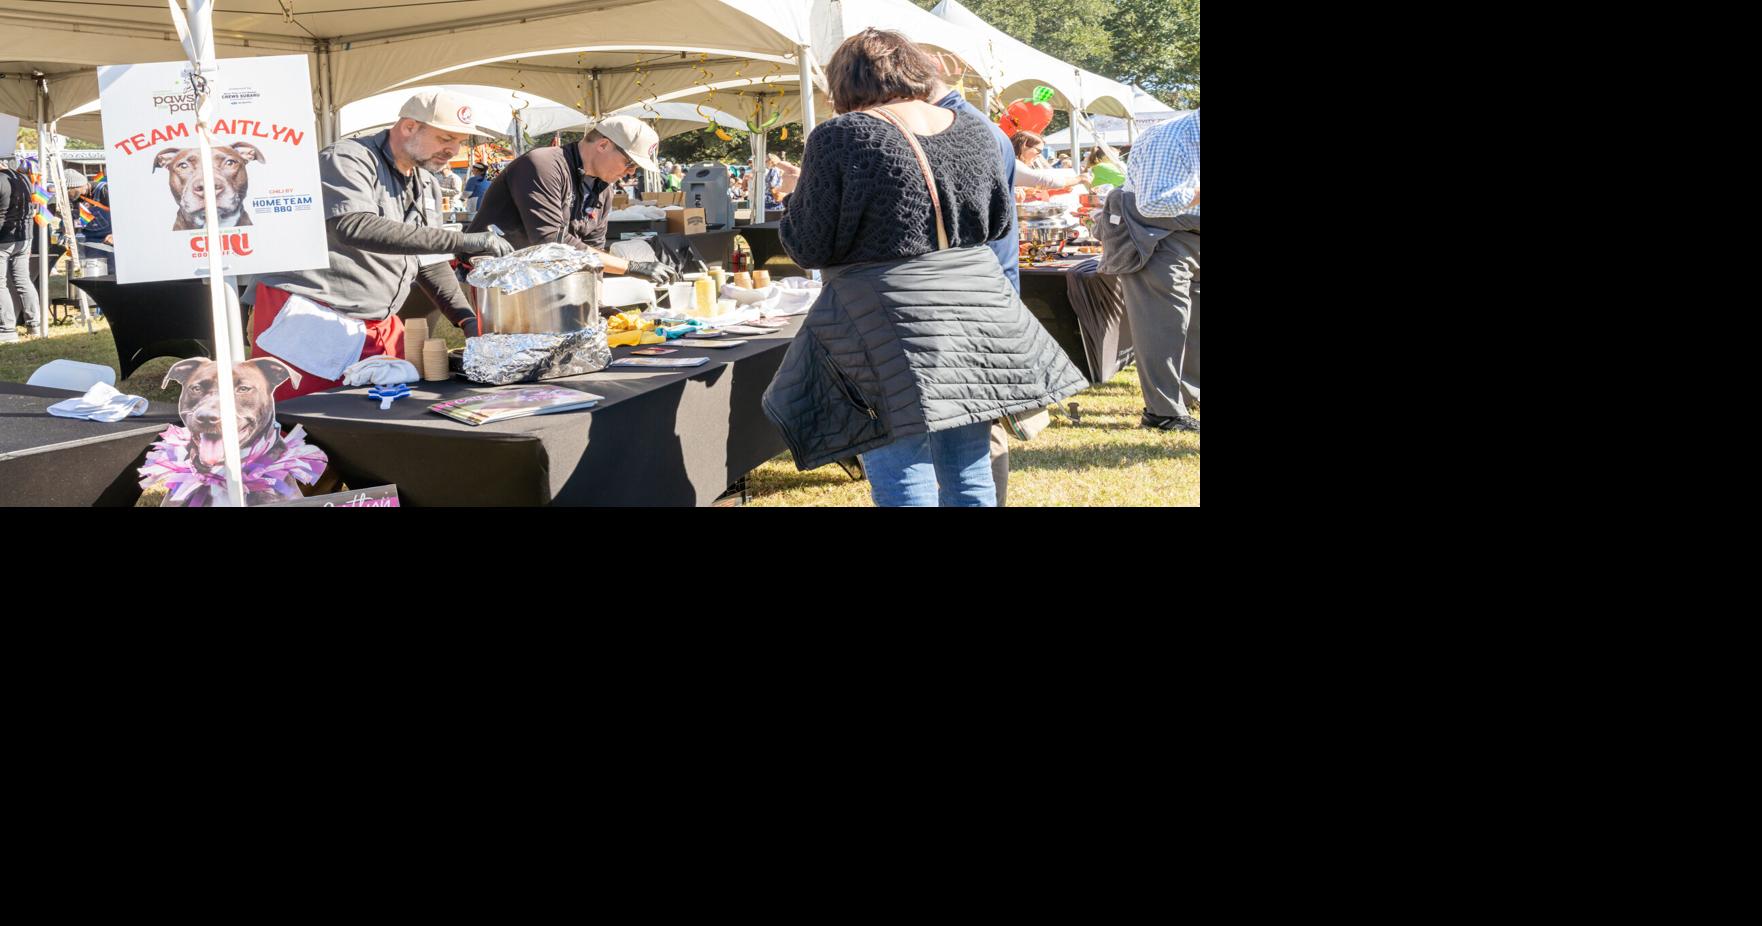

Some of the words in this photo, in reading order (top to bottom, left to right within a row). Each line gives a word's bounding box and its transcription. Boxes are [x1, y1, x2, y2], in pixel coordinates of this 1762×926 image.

[152, 94, 195, 107] paws
[169, 103, 196, 115] par
[114, 122, 189, 155] TEAM
[252, 199, 281, 207] HOME
[283, 196, 312, 205] TEAM
[273, 205, 292, 213] BBQ
